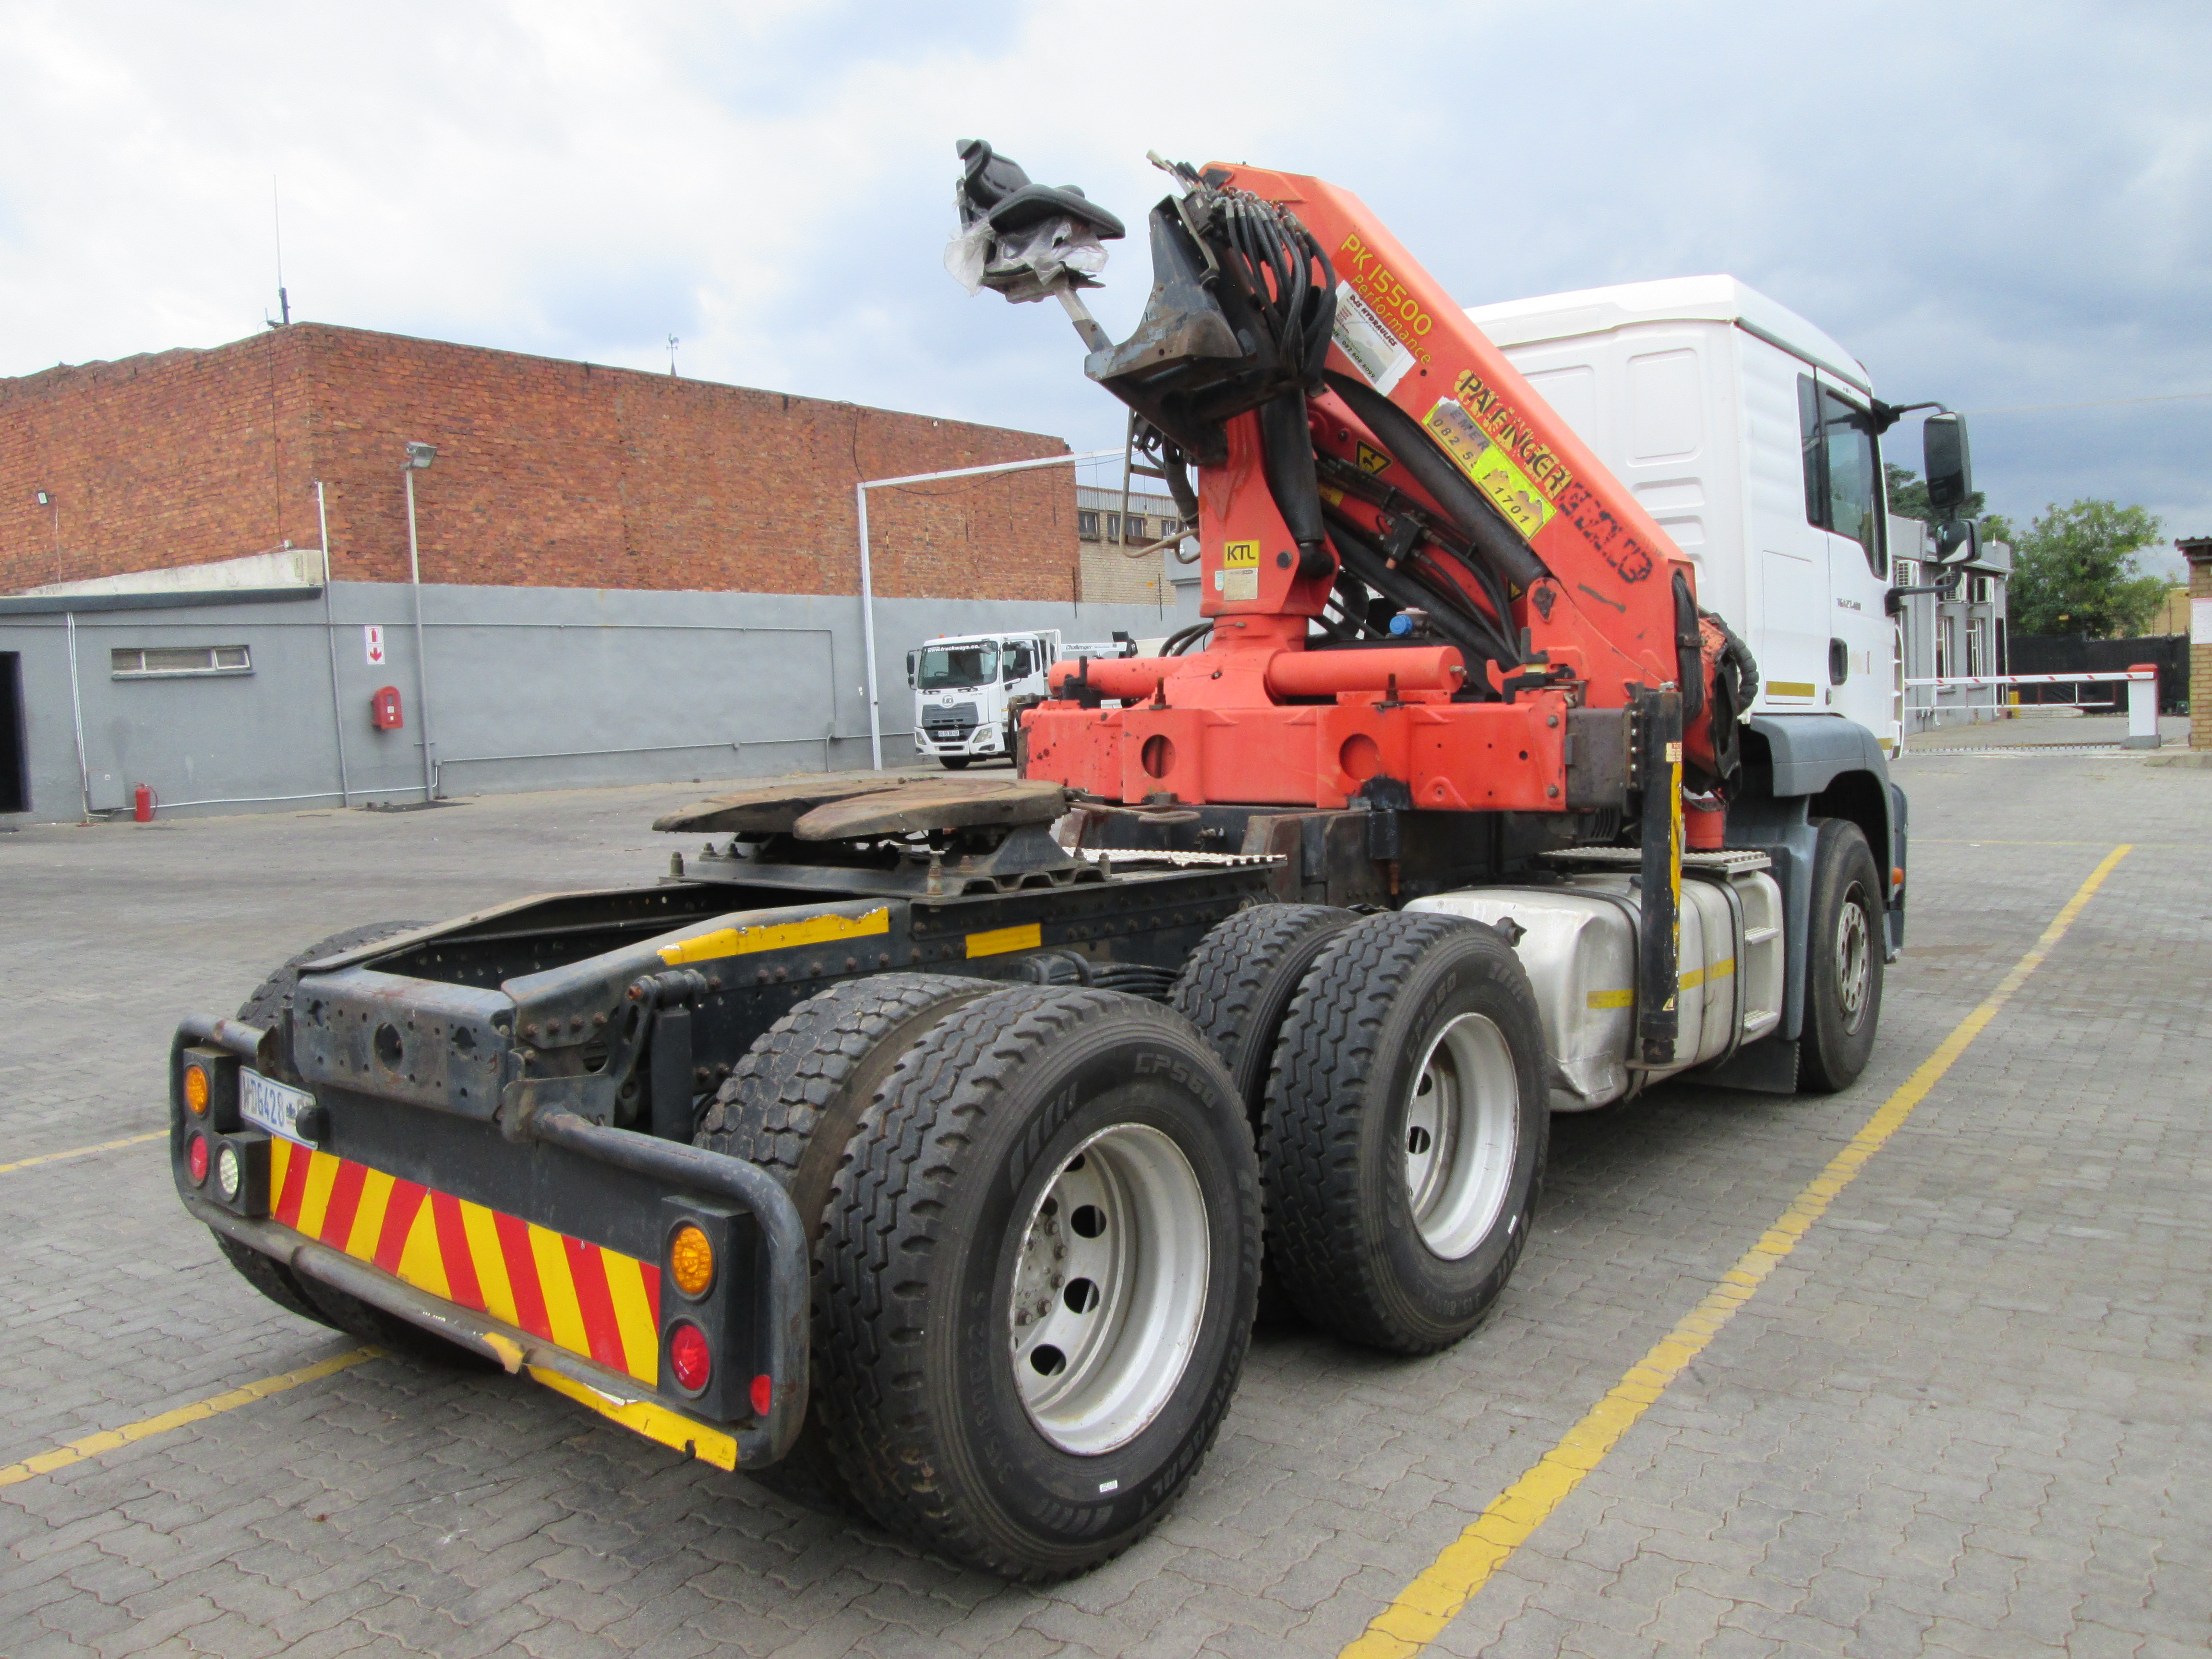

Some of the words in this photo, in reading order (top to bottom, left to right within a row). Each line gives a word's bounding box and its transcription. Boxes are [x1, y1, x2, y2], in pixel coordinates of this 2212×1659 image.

[1340, 233, 1373, 271] PK
[1368, 264, 1432, 335] 15500
[1350, 274, 1431, 365] Performance
[1349, 294, 1362, 308] DJS
[1361, 308, 1397, 346] HYDRAULICS
[1433, 419, 1460, 446] 082
[1494, 487, 1529, 524] 1701
[1227, 544, 1256, 561] KTL
[927, 644, 987, 653] www.truckways.co.
